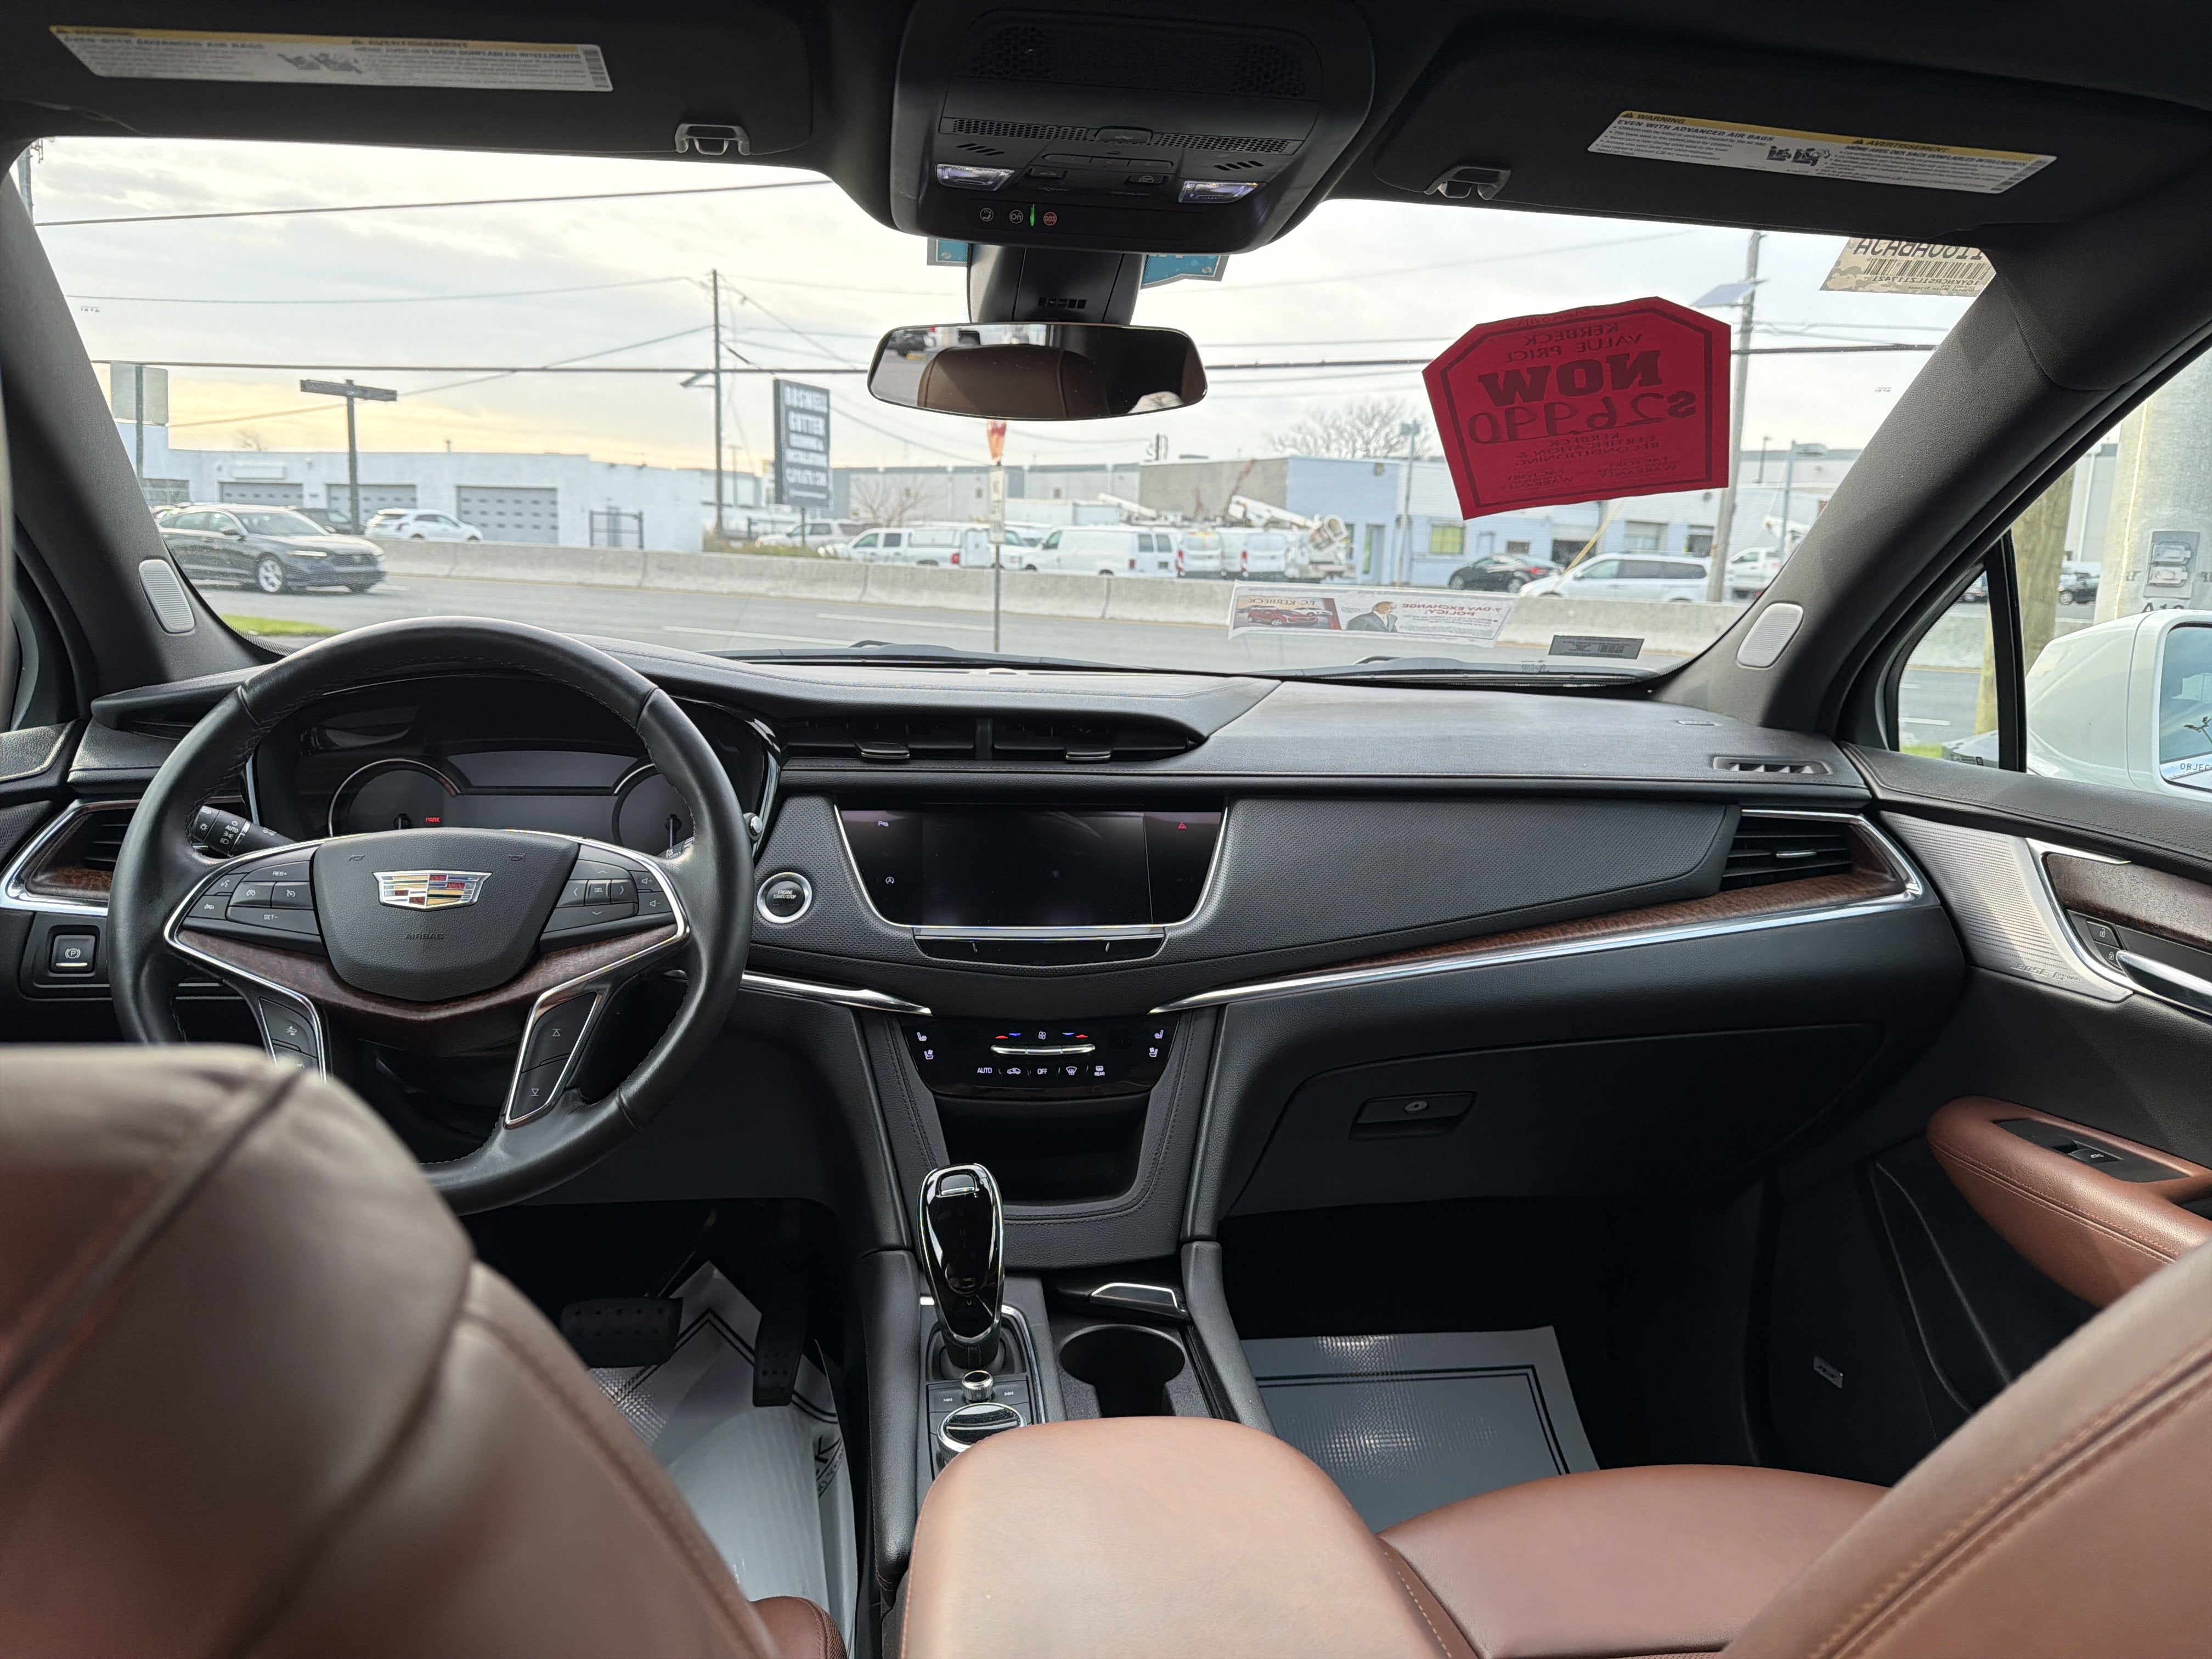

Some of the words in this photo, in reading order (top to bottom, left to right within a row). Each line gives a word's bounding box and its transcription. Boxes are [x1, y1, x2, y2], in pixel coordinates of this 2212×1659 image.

[1637, 114, 1686, 125] WARNING
[1672, 126, 1726, 136] ADVANCED
[2180, 763, 2212, 771] OBJEC
[225, 825, 239, 833] AUTO
[2012, 963, 2053, 978] BOSE
